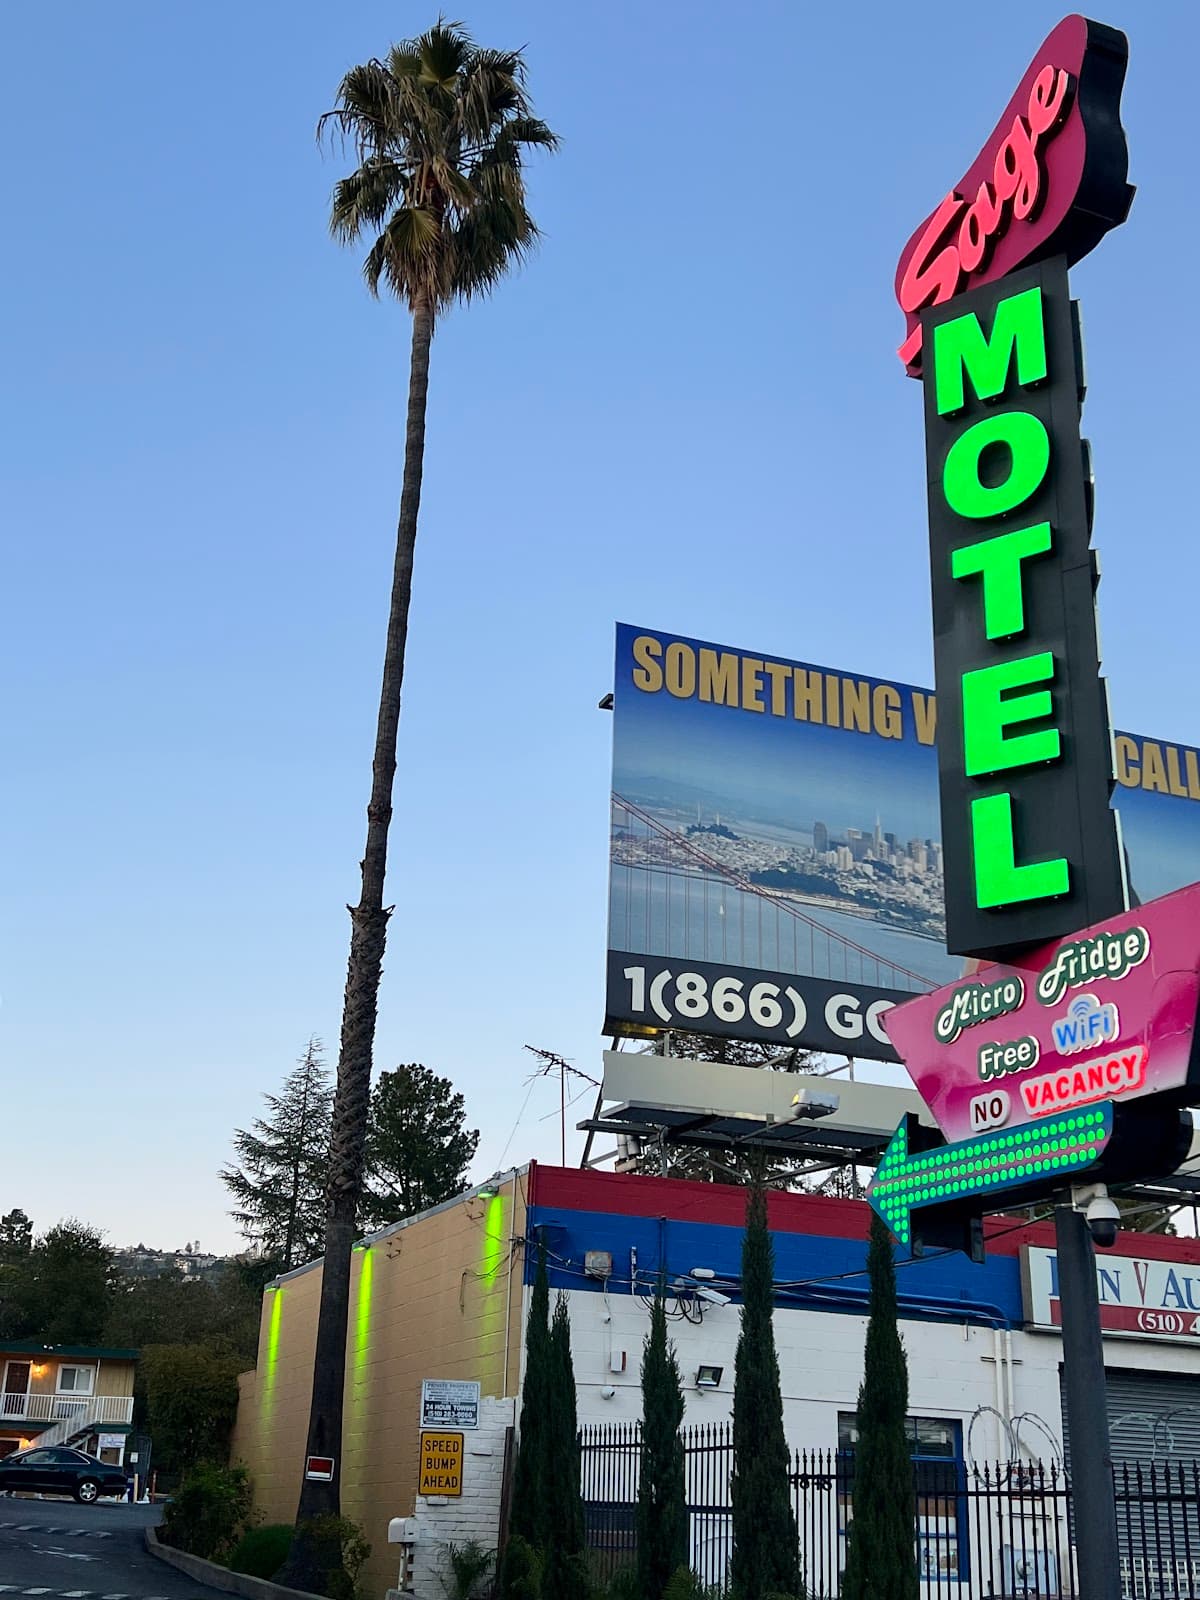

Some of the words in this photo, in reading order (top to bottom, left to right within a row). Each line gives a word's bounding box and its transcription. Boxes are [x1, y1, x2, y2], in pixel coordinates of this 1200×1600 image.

[897, 65, 1072, 365] Sage
[934, 287, 1070, 909] MOTEL
[633, 636, 902, 740] SOMETHING
[1114, 735, 1200, 800] CALL
[1038, 934, 1140, 998] Fridge
[623, 966, 807, 1038] 1(866)
[938, 981, 1016, 1036] Micro
[1056, 1011, 1111, 1047] WiFi
[980, 1042, 1031, 1074] Free
[1024, 1053, 1138, 1109] VACANCY
[974, 1096, 1003, 1123] NO
[1137, 1311, 1184, 1332] (510)
[425, 1441, 459, 1453] SPEED
[426, 1458, 456, 1470] BUMP
[423, 1476, 458, 1489] AHEAD
